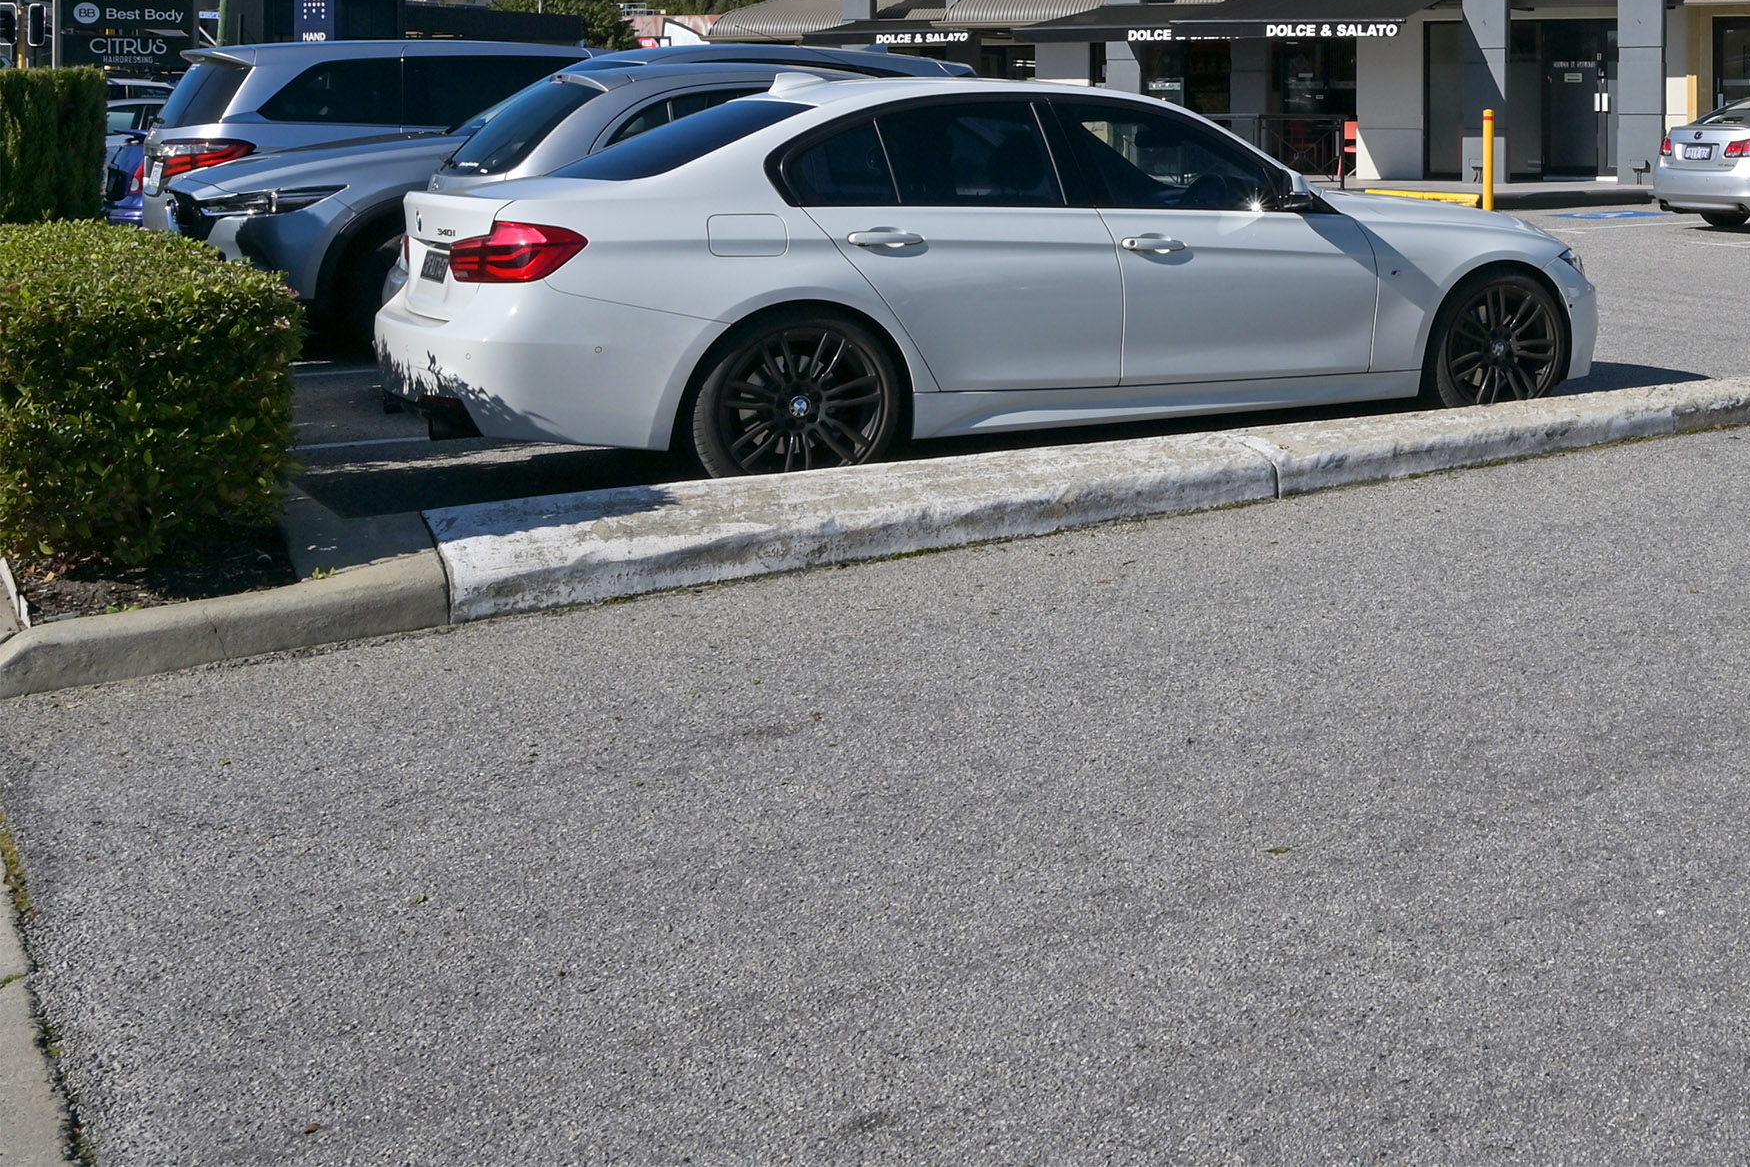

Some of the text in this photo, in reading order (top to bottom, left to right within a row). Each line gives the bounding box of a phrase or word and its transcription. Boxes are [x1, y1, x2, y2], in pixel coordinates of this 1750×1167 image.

[78, 8, 184, 23] BB Best Body
[302, 32, 326, 41] HAND
[1128, 29, 1172, 41] DOLCE
[1266, 24, 1398, 37] DOLCE & SALATO
[876, 33, 968, 44] DOLCE & SALATO
[89, 38, 167, 55] CITRUS
[103, 56, 153, 64] HAIRDRESSING
